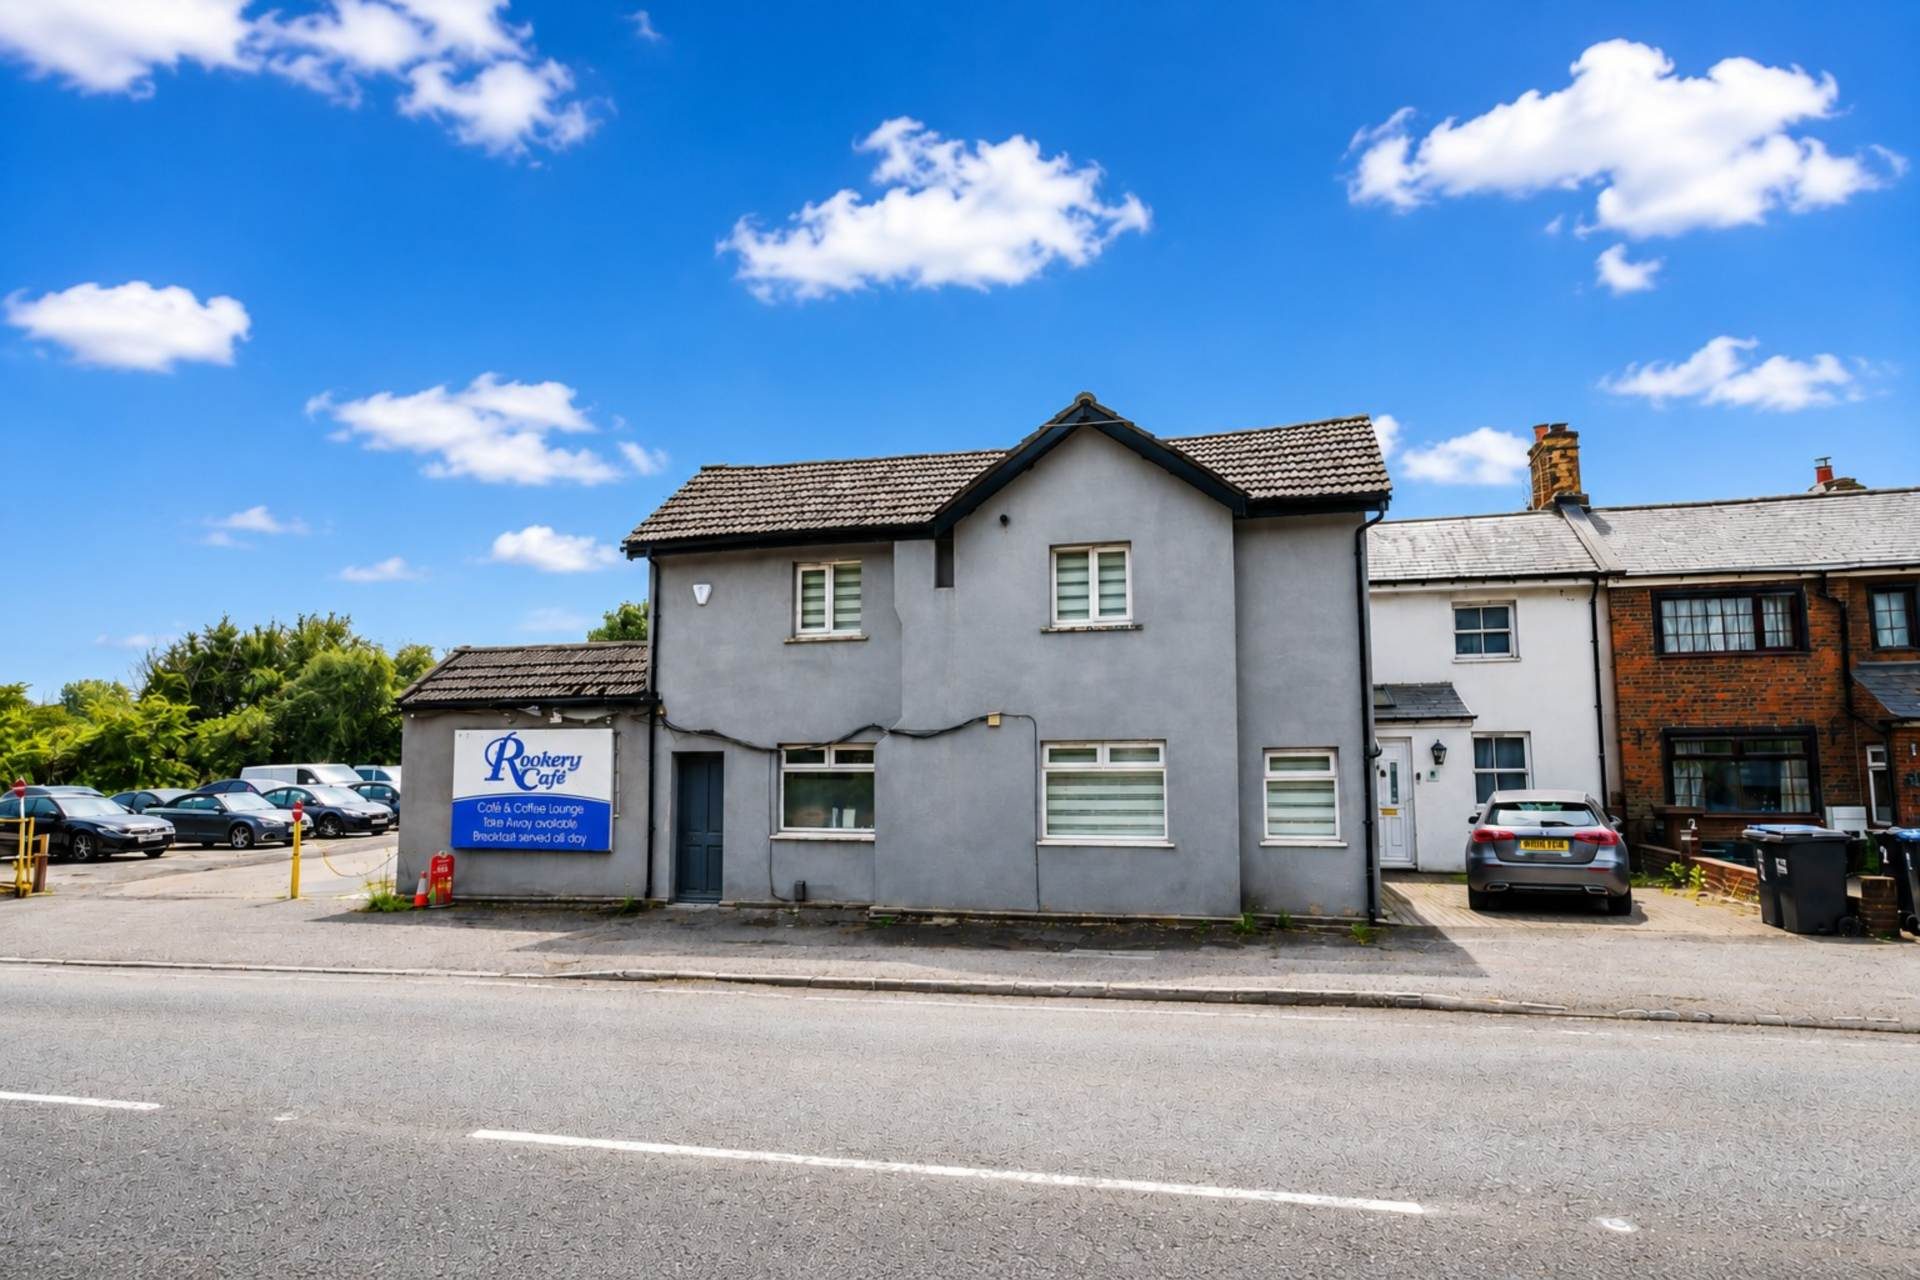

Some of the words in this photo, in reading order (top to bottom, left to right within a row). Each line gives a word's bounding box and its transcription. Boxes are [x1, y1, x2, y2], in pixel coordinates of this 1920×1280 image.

[484, 731, 582, 782] Rookery
[521, 767, 567, 791] Café
[504, 802, 511, 812] &
[513, 802, 546, 814] Coffee
[549, 804, 584, 817] Lounge
[484, 817, 504, 828] Take
[506, 818, 532, 830] Away
[535, 819, 577, 829] available
[473, 830, 516, 842] Breakfast
[518, 833, 550, 843] served
[568, 834, 587, 847] day
